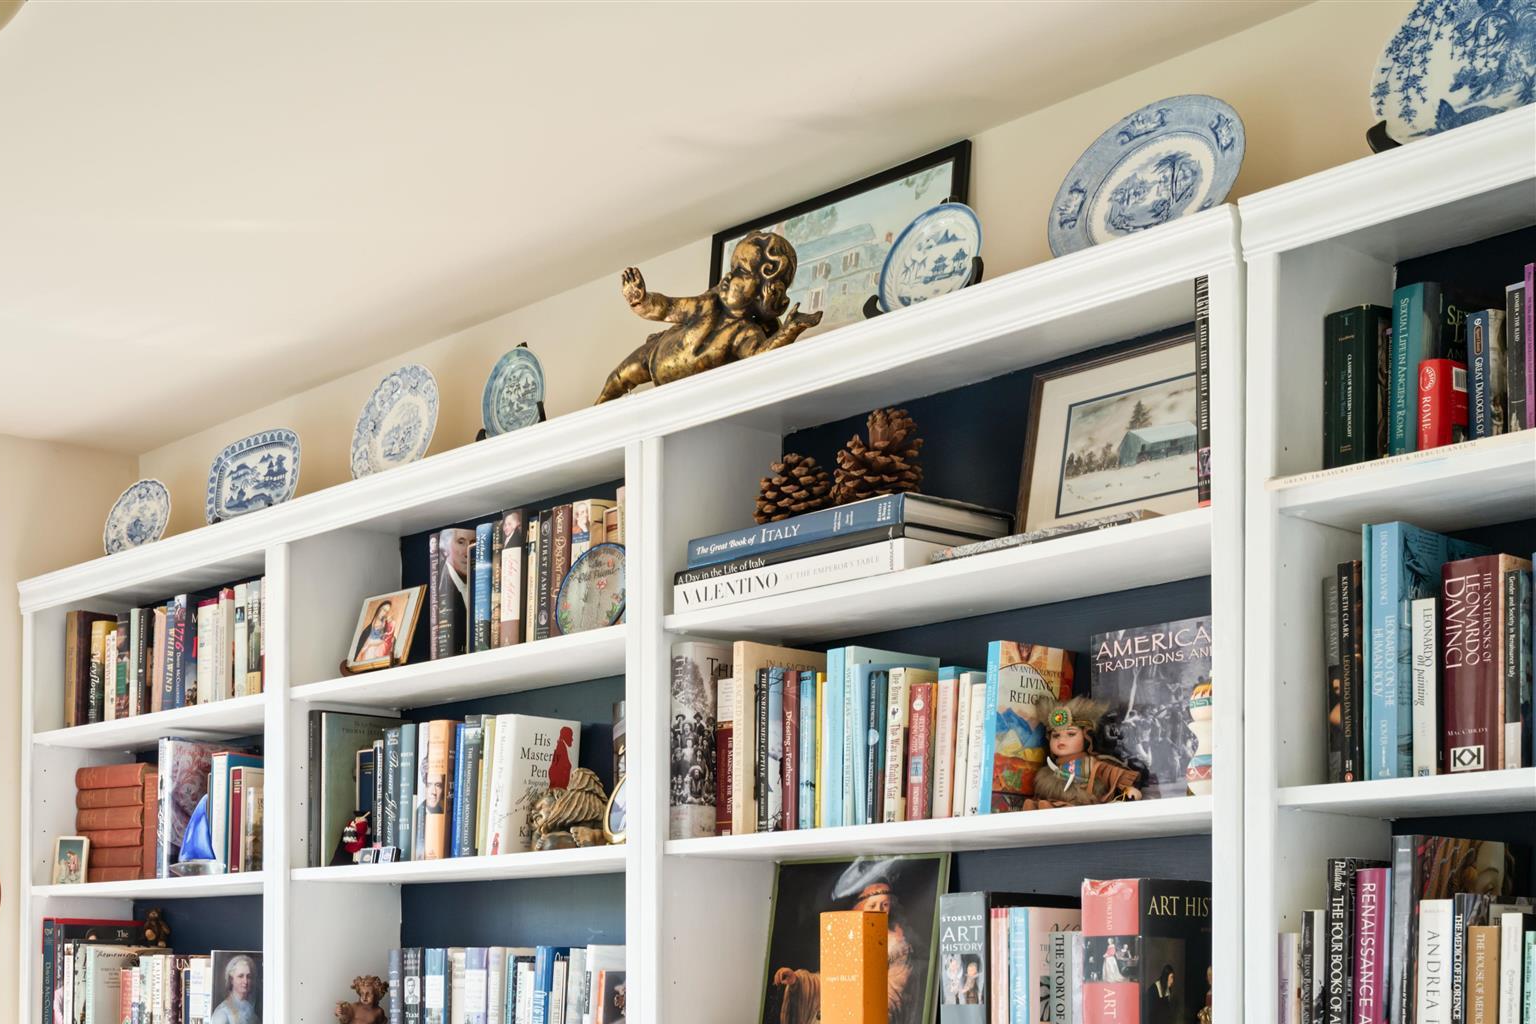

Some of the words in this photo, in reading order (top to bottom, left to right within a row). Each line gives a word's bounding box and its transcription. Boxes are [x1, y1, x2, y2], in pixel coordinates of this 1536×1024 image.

[1400, 298, 1409, 334] SEXUAL
[1399, 336, 1409, 359] LIFE
[1399, 360, 1407, 372] IN
[1475, 356, 1484, 380] GREAT
[1397, 373, 1407, 411] ANCIENT
[1475, 382, 1484, 422] DIALOGUES
[1396, 412, 1405, 439] ROME
[1422, 396, 1432, 431] ROME
[1475, 424, 1484, 435] OF
[539, 538, 549, 569] FIRST
[696, 545, 709, 555] The
[710, 542, 727, 554] Great
[728, 538, 746, 548] Book
[745, 535, 755, 546] of
[760, 524, 800, 543] ITALY
[678, 576, 684, 584] A
[685, 574, 700, 583] Day
[711, 568, 722, 577] the
[724, 565, 737, 574] Life
[739, 563, 747, 571] of
[749, 558, 765, 568] Italy
[1483, 572, 1491, 590] THE
[539, 571, 548, 607] FAMILY
[683, 573, 778, 605] VALENTINO
[1466, 575, 1480, 666] LEONARDO
[1483, 593, 1492, 650] NOTEBOOKS
[175, 623, 185, 652] 1776
[1096, 626, 1212, 660] AMERICA
[1423, 607, 1433, 667] LEONARDO
[166, 628, 175, 693] WHIRLWIND
[1096, 652, 1183, 673] TRADITIONS
[1417, 655, 1424, 666] on
[1483, 651, 1491, 663] OF
[89, 652, 100, 707] Mayflower
[1020, 676, 1054, 690] LIVING
[1343, 655, 1351, 701] LEONARDO
[1414, 668, 1424, 706] painting
[1344, 703, 1350, 712] DA
[534, 733, 551, 746] His
[386, 752, 399, 795] Thomas
[531, 765, 547, 778] Pen
[385, 793, 397, 843] Jefferson
[1333, 860, 1346, 891] Palladio
[1148, 896, 1179, 916] ART
[1332, 896, 1344, 919] THE
[117, 930, 129, 938] The
[943, 926, 983, 941] ART
[1331, 922, 1344, 952] FOUR
[1455, 914, 1463, 932] THE
[943, 942, 983, 951] HISTORY
[1055, 935, 1064, 968] THE
[1359, 883, 1376, 1009] RENAISSANCE
[1476, 934, 1485, 950] THE
[1330, 953, 1344, 995] BOOKS
[1426, 929, 1441, 1010] ANDREA
[1476, 952, 1485, 980] HOUSE
[1055, 970, 1064, 1002] STORY
[1476, 982, 1484, 993] OF
[1055, 1003, 1064, 1022] OF
[1103, 988, 1116, 1017] ART
[1329, 997, 1342, 1012] OF
